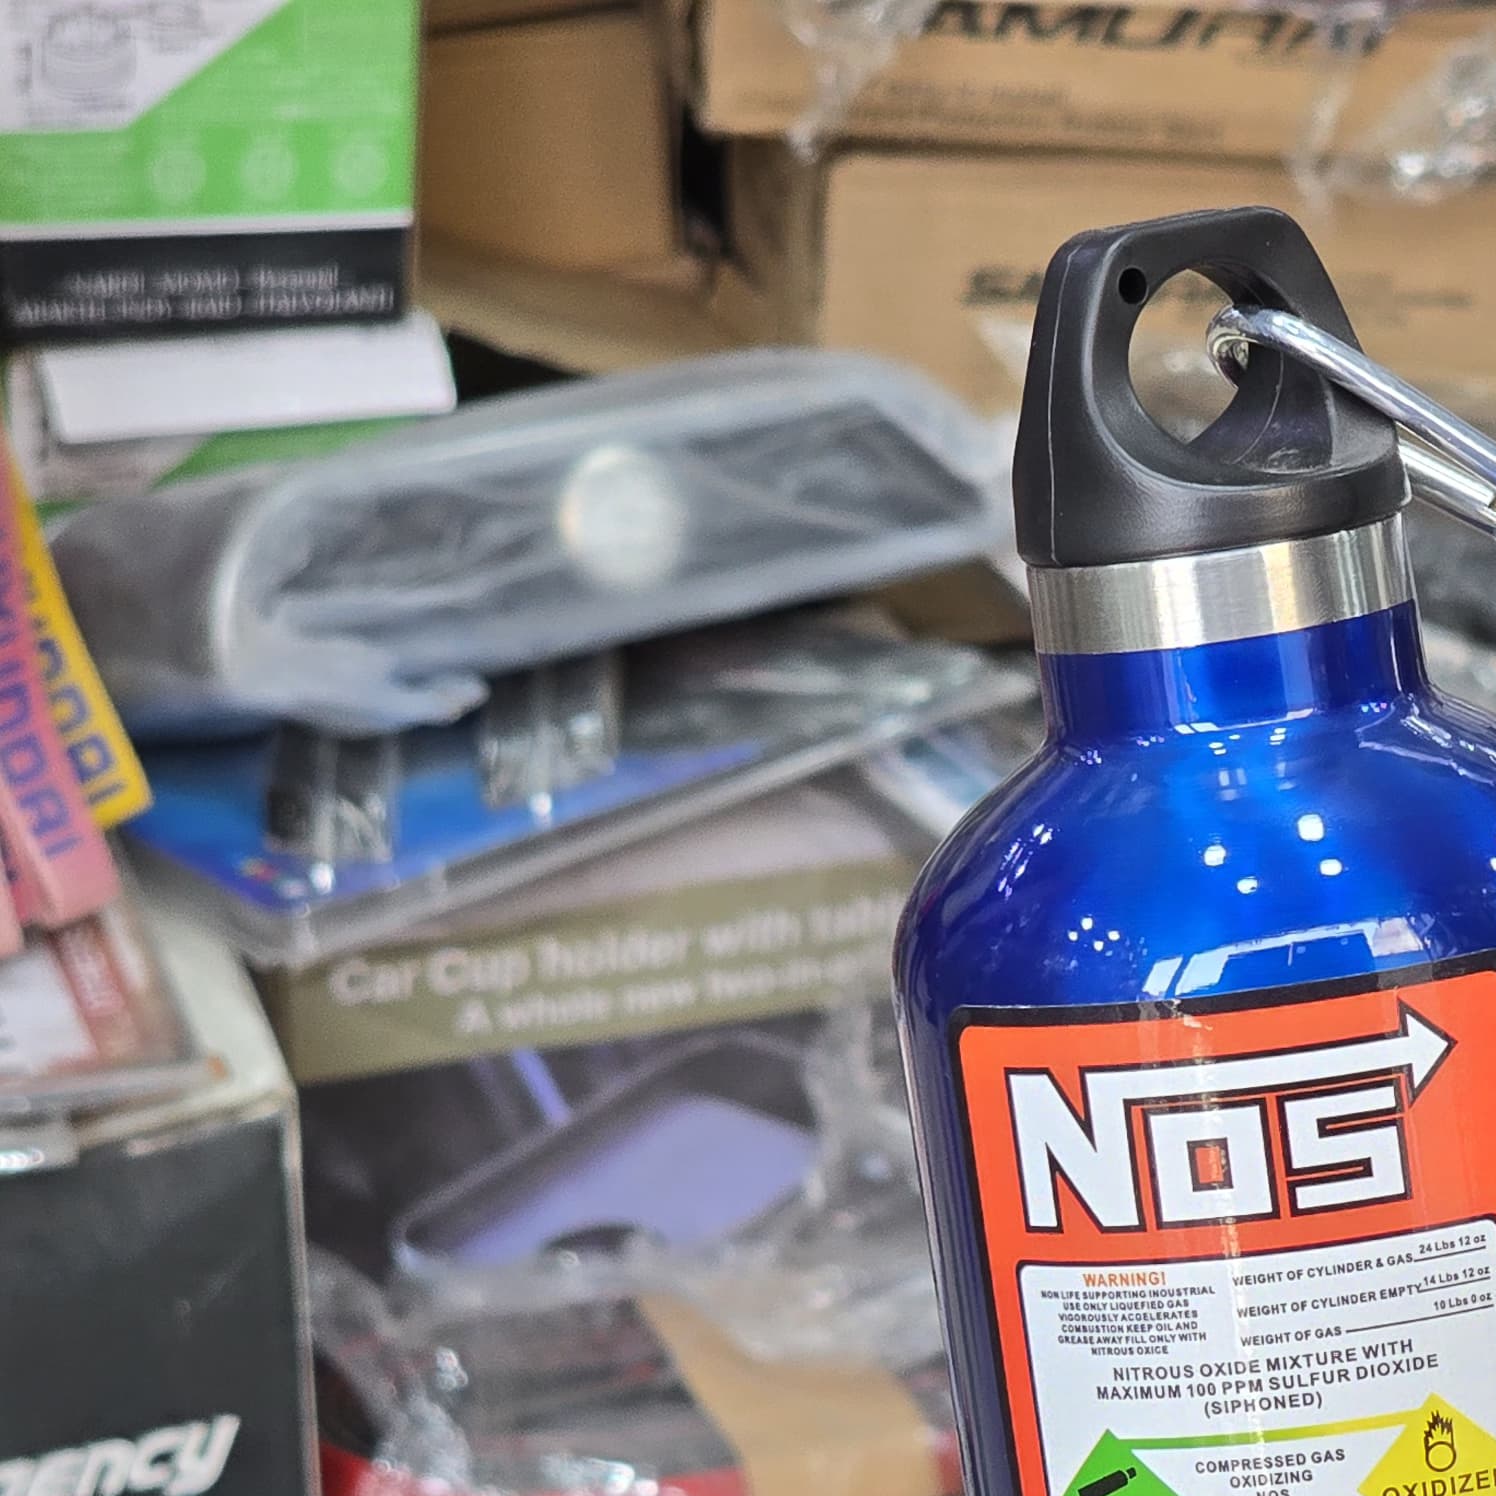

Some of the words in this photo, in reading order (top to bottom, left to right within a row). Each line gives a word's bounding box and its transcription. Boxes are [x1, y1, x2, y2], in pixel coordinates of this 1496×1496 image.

[1005, 1001, 1457, 1233] NOS
[1419, 1243, 1433, 1255] 24
[1434, 1240, 1456, 1252] Lbs
[1459, 1235, 1471, 1247] 12
[1473, 1233, 1487, 1243] oz
[1082, 1271, 1167, 1287] WARNING!
[1232, 1271, 1283, 1286] WEIGHT
[1287, 1269, 1304, 1281] OF
[1307, 1260, 1373, 1279] CYLINDER
[1375, 1257, 1385, 1267] &
[1387, 1252, 1414, 1266] GAS
[1423, 1275, 1436, 1287] 14
[1438, 1271, 1459, 1285] Lbs
[1462, 1267, 1475, 1279] 12
[1477, 1265, 1491, 1276] oz
[1061, 1290, 1080, 1300] LIFE
[1083, 1289, 1146, 1300] SUPPORTING
[1063, 1302, 1081, 1311] USE
[1083, 1301, 1108, 1311] ONLY
[1110, 1300, 1164, 1311] LIQUEFIED
[1167, 1299, 1189, 1308] GAS
[1237, 1303, 1287, 1318] WEIGHT
[1291, 1300, 1308, 1312] OF
[1311, 1291, 1377, 1310] CYLINDER
[1380, 1283, 1422, 1299] EMPTY
[1433, 1299, 1447, 1311] 10
[1448, 1296, 1469, 1309] Lbs
[1479, 1291, 1492, 1302] oz
[1127, 1323, 1153, 1333] KEEP
[1156, 1322, 1173, 1331] OIL
[1175, 1321, 1198, 1330] AND
[1240, 1332, 1291, 1347] WEIGHT
[1294, 1329, 1312, 1341] OF
[1314, 1326, 1342, 1338] GAS
[1096, 1335, 1123, 1345] AWAY
[1126, 1334, 1147, 1344] FILL
[1149, 1333, 1176, 1343] ONLY
[1178, 1332, 1207, 1342] WITH
[1091, 1346, 1134, 1356] NITROUS
[1113, 1363, 1194, 1382] NITROUS
[1200, 1359, 1261, 1377] OXIDE
[1266, 1348, 1358, 1372] MIXTURE
[1363, 1339, 1414, 1360] WITH
[1096, 1384, 1181, 1401] MAXIMUM
[1186, 1381, 1217, 1398] 100
[1222, 1377, 1263, 1395] PPM
[1268, 1368, 1351, 1391] SULFUR
[1356, 1353, 1440, 1380] DIOXIDE
[1204, 1392, 1324, 1418] (SIPHONED)
[1195, 1453, 1306, 1473] COMPRESSED
[1311, 1449, 1346, 1464] GAS
[1230, 1469, 1313, 1488] OXIDIZING
